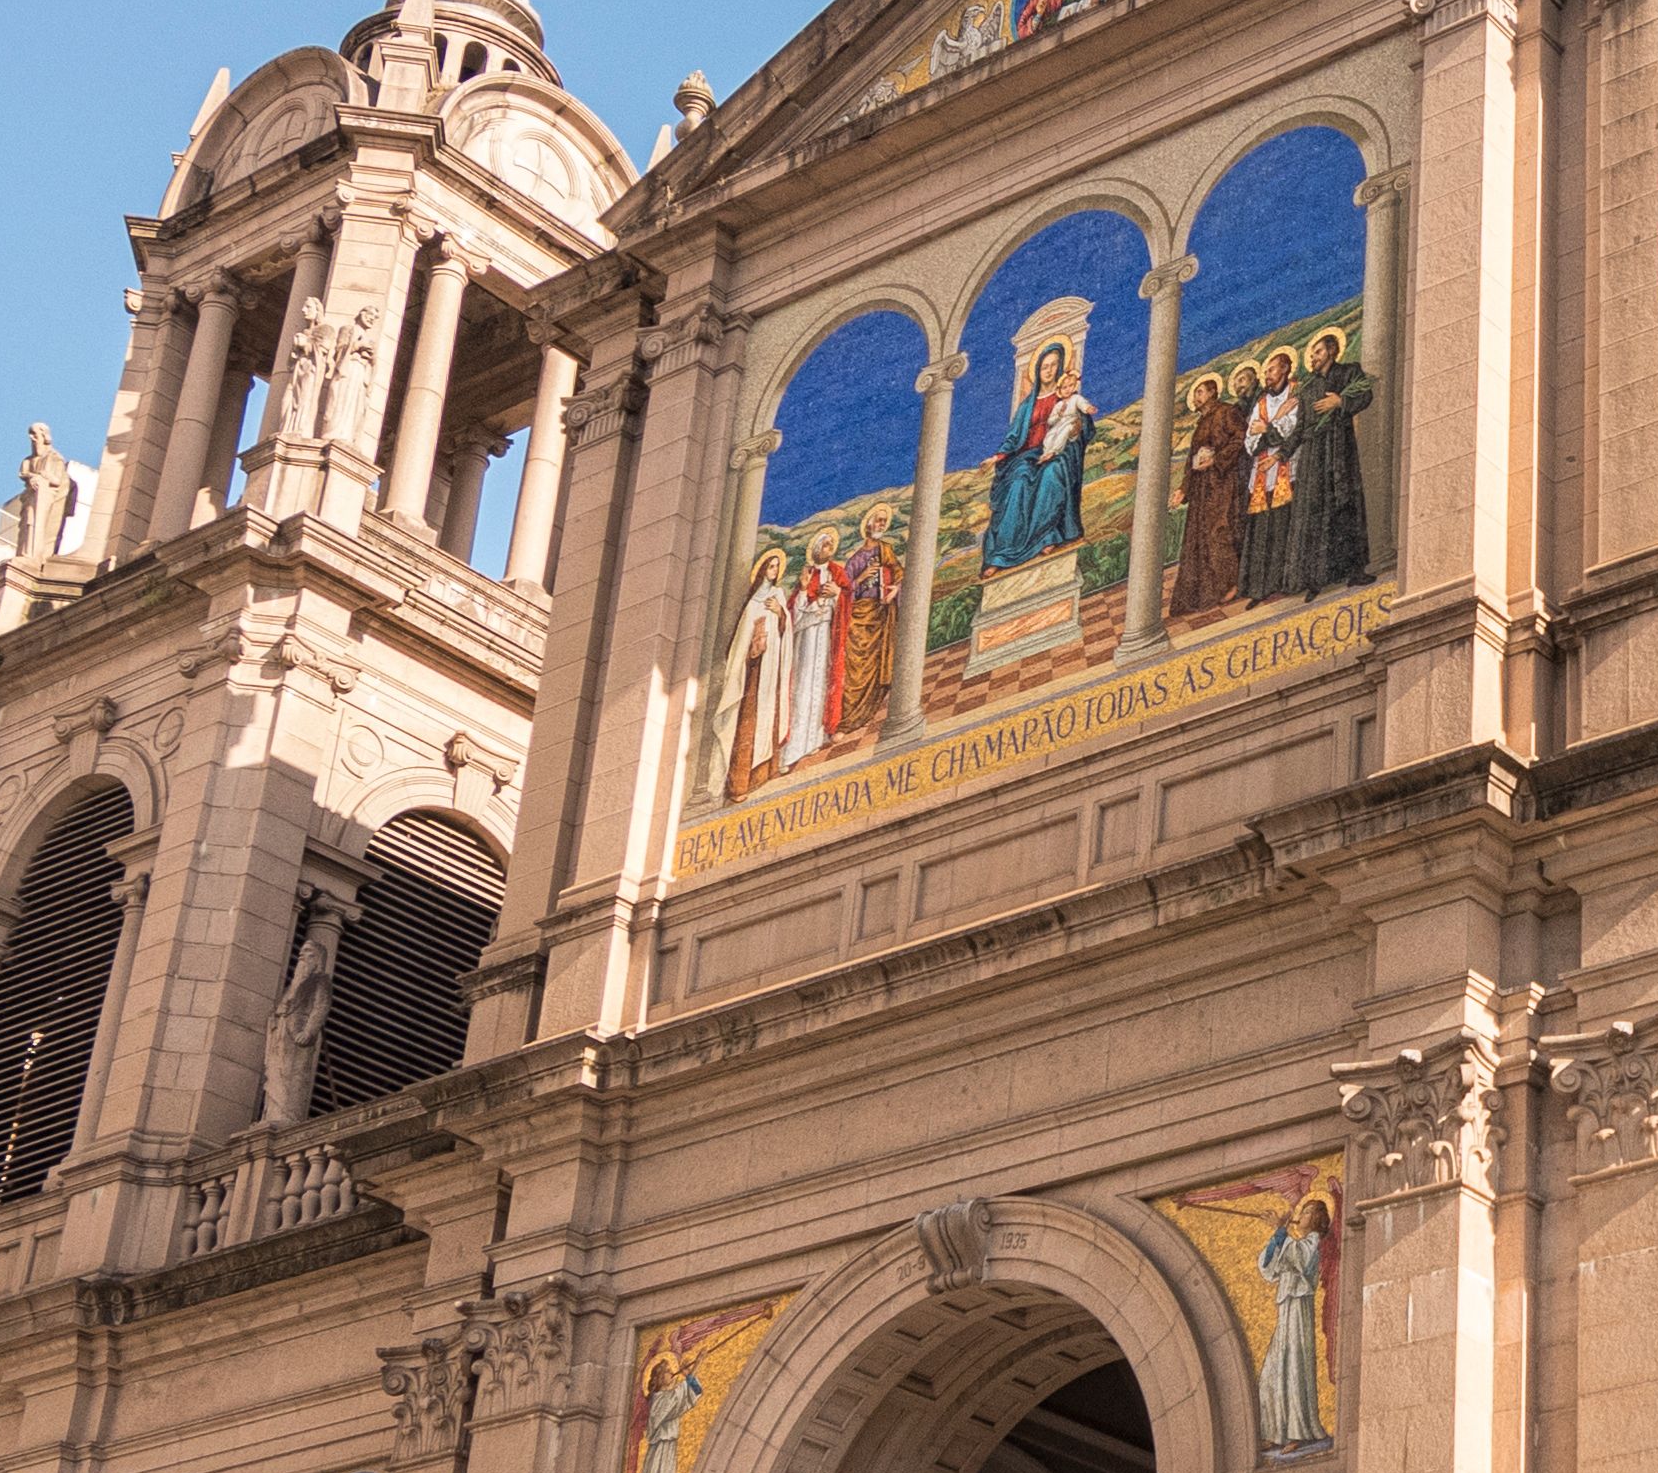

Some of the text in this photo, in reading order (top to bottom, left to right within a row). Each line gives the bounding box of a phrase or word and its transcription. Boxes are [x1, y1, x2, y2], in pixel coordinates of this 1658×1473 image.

[679, 780, 873, 870] BEM-AVENTURADA
[883, 759, 920, 800] ME
[932, 705, 1076, 783] CHAMARÃO
[1083, 672, 1168, 731] TODAS
[1179, 657, 1215, 698] AS
[1001, 1232, 1030, 1250] 1935
